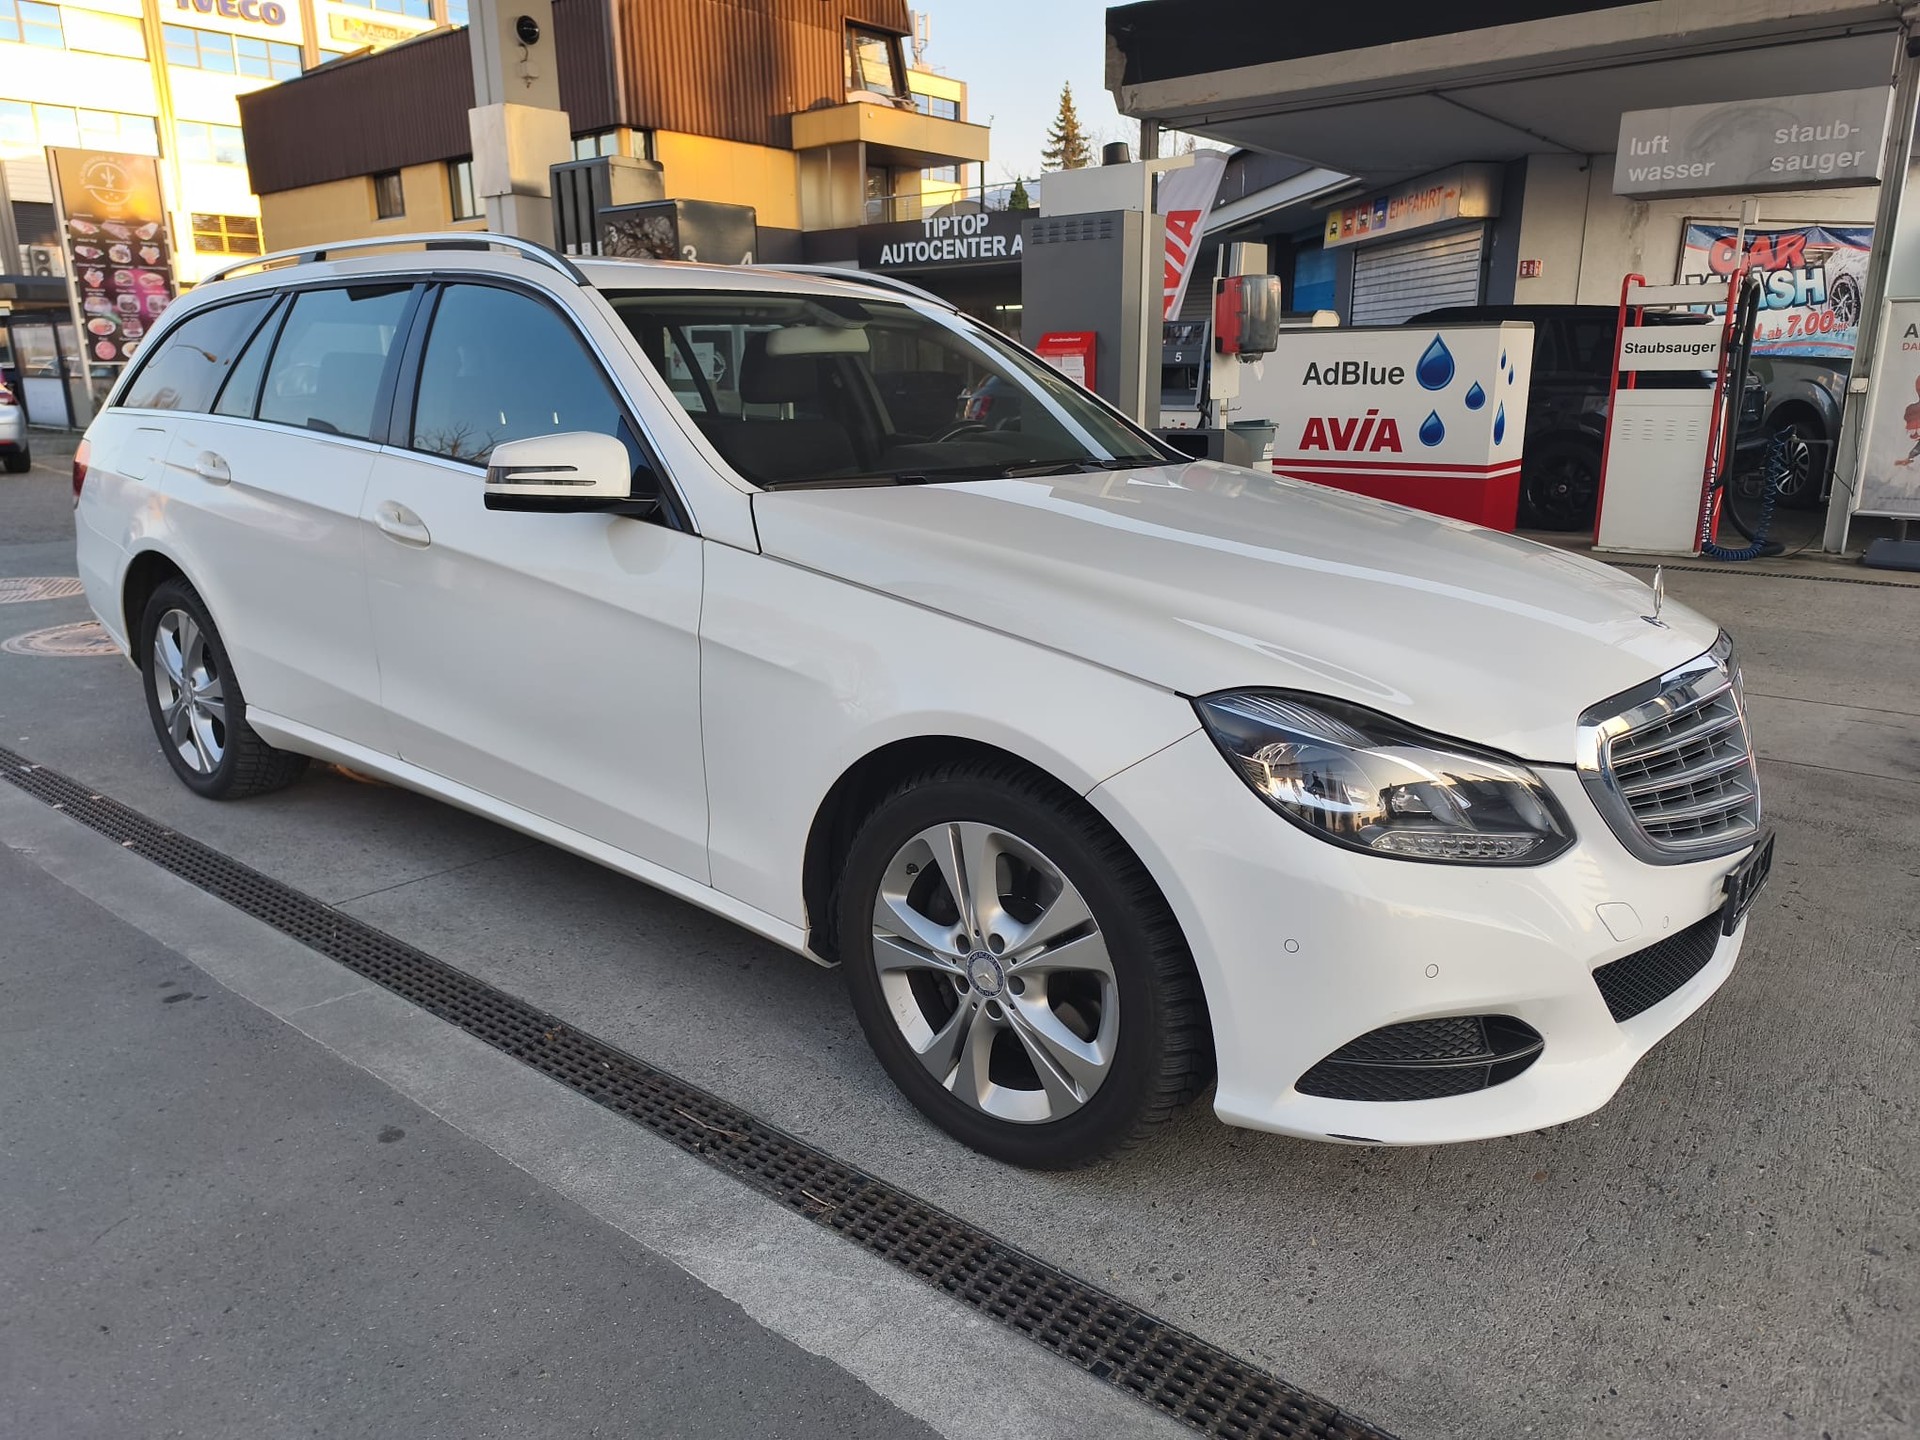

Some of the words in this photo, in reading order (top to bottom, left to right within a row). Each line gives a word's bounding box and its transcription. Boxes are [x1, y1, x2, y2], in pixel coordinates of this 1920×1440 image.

[1774, 119, 1860, 144] staub-
[1630, 135, 1669, 156] luft
[1629, 161, 1716, 182] wasser
[1770, 150, 1866, 174] sauger
[1389, 185, 1444, 219] EINFAHRT
[922, 213, 989, 238] TIPTOP
[880, 235, 1007, 265] AUTOCENTER
[1708, 233, 1808, 277] CAR
[1768, 326, 1782, 340] ab
[1787, 310, 1834, 338] 7.00
[1175, 353, 1183, 362] 5
[1624, 342, 1717, 356] Staubsauger
[1302, 361, 1405, 386] AdBlue
